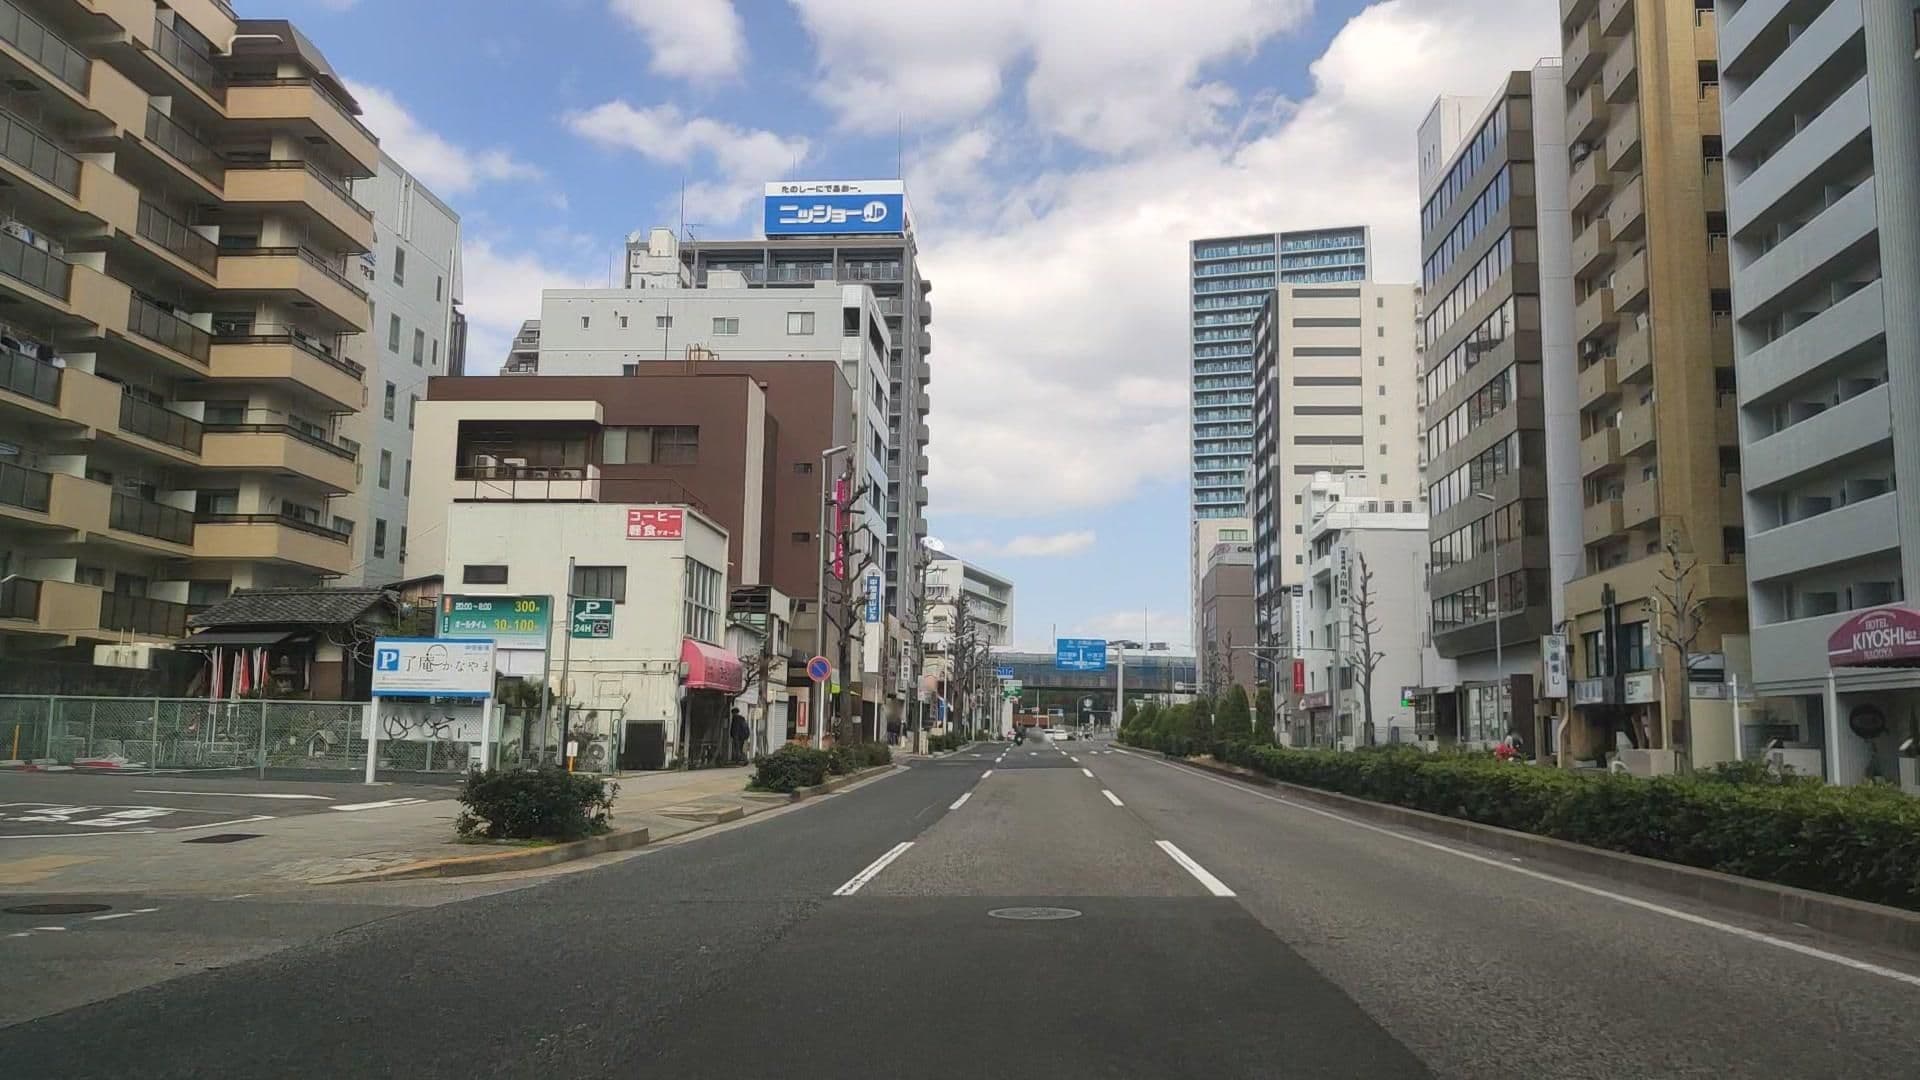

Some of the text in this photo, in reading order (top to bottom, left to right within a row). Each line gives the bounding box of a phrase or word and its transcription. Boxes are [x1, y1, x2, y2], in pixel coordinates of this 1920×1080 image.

[779, 204, 862, 224] ニッショー
[630, 511, 681, 522] コーヒー
[585, 601, 601, 614] P
[455, 620, 487, 629] オールタイム
[573, 623, 592, 633] 24H
[1864, 617, 1889, 630] HOTEL
[1852, 626, 1905, 651] KIYOSHI
[379, 650, 398, 670] P
